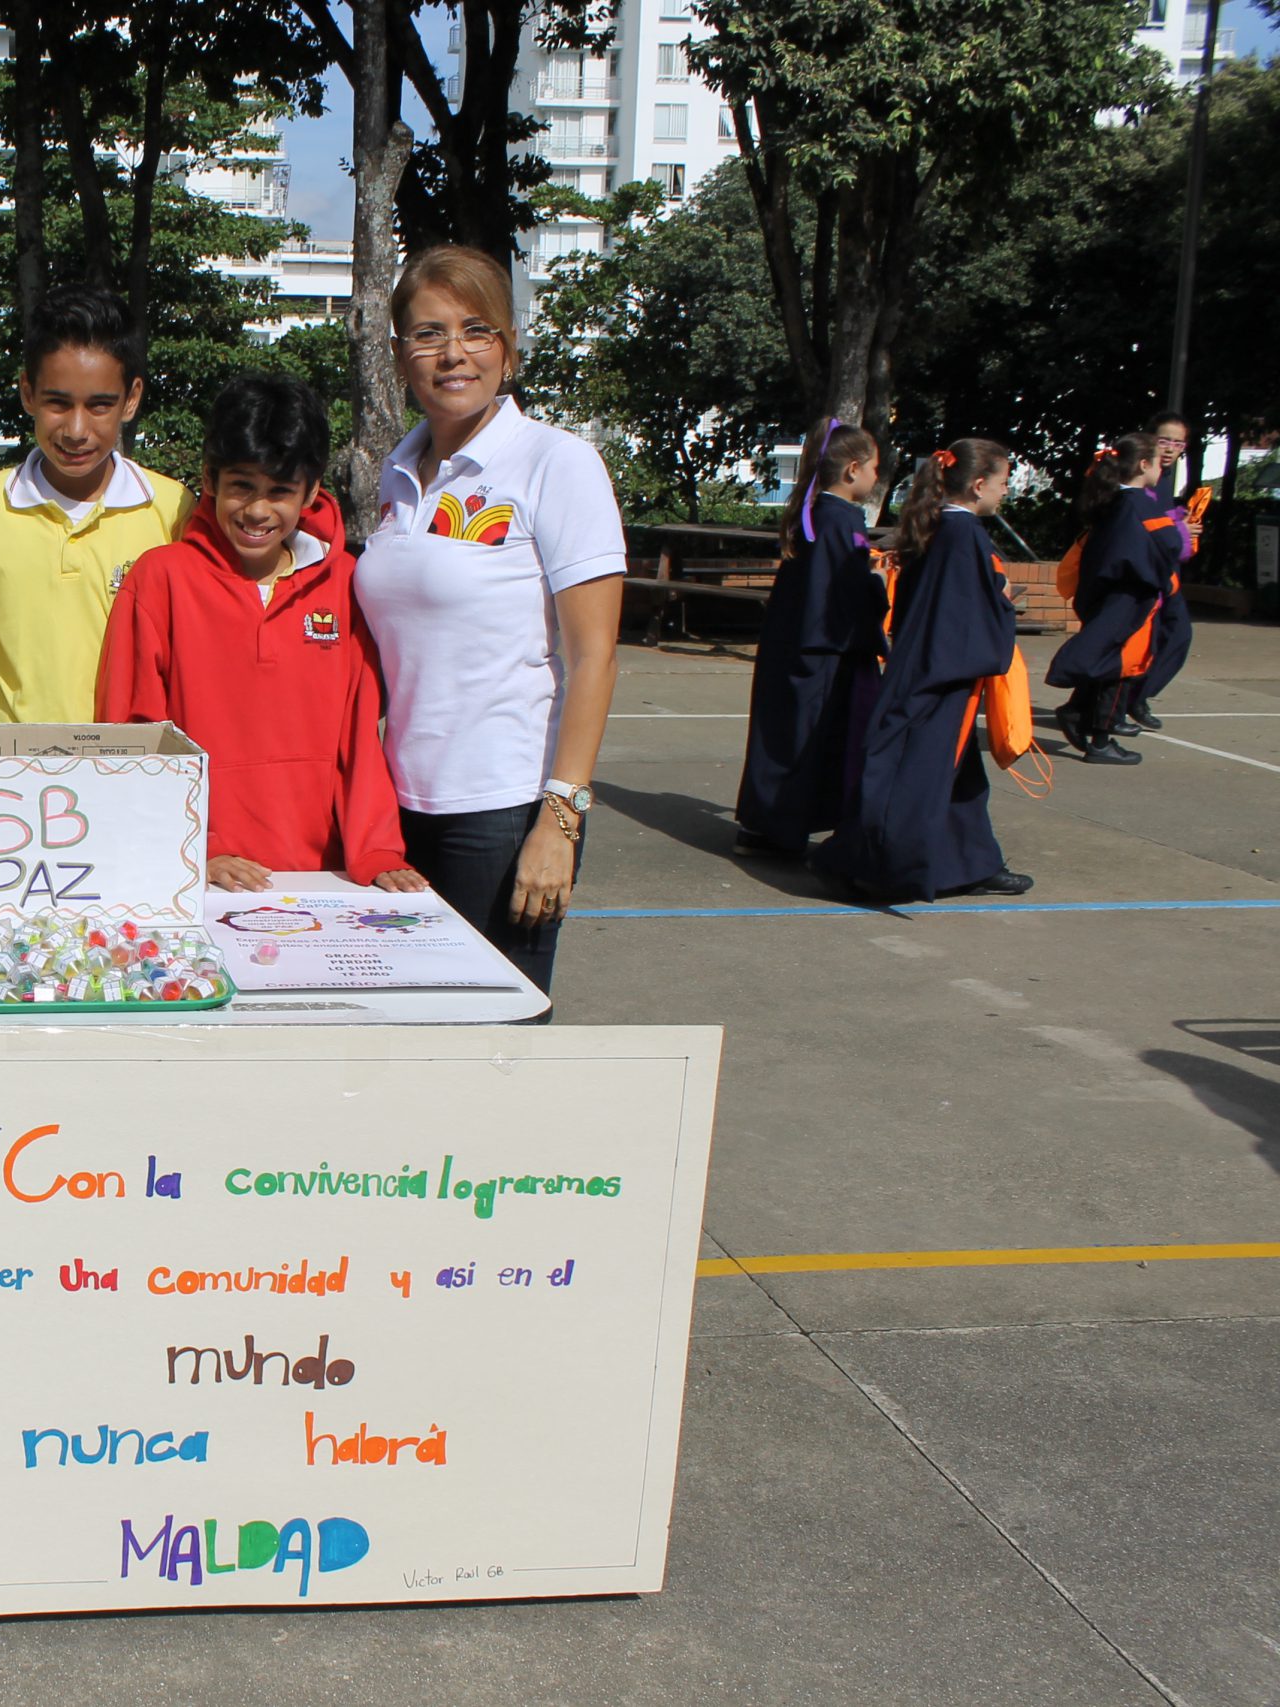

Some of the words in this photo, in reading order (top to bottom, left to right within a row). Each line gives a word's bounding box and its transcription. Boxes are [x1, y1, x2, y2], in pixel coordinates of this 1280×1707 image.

[475, 484, 493, 494] PAZ
[73, 734, 101, 742] BOGOTA
[145, 1154, 182, 1199] la
[224, 1161, 428, 1199] convivencia
[147, 1255, 349, 1296] comunidad
[390, 1270, 411, 1299] y
[435, 1261, 476, 1289] asi
[496, 1266, 532, 1287] en
[546, 1258, 575, 1287] el
[166, 1334, 356, 1390] mundo
[21, 1424, 210, 1469] nunca
[304, 1411, 448, 1466] habrá
[120, 1514, 370, 1598] MALDAD
[402, 1568, 445, 1589] Victor
